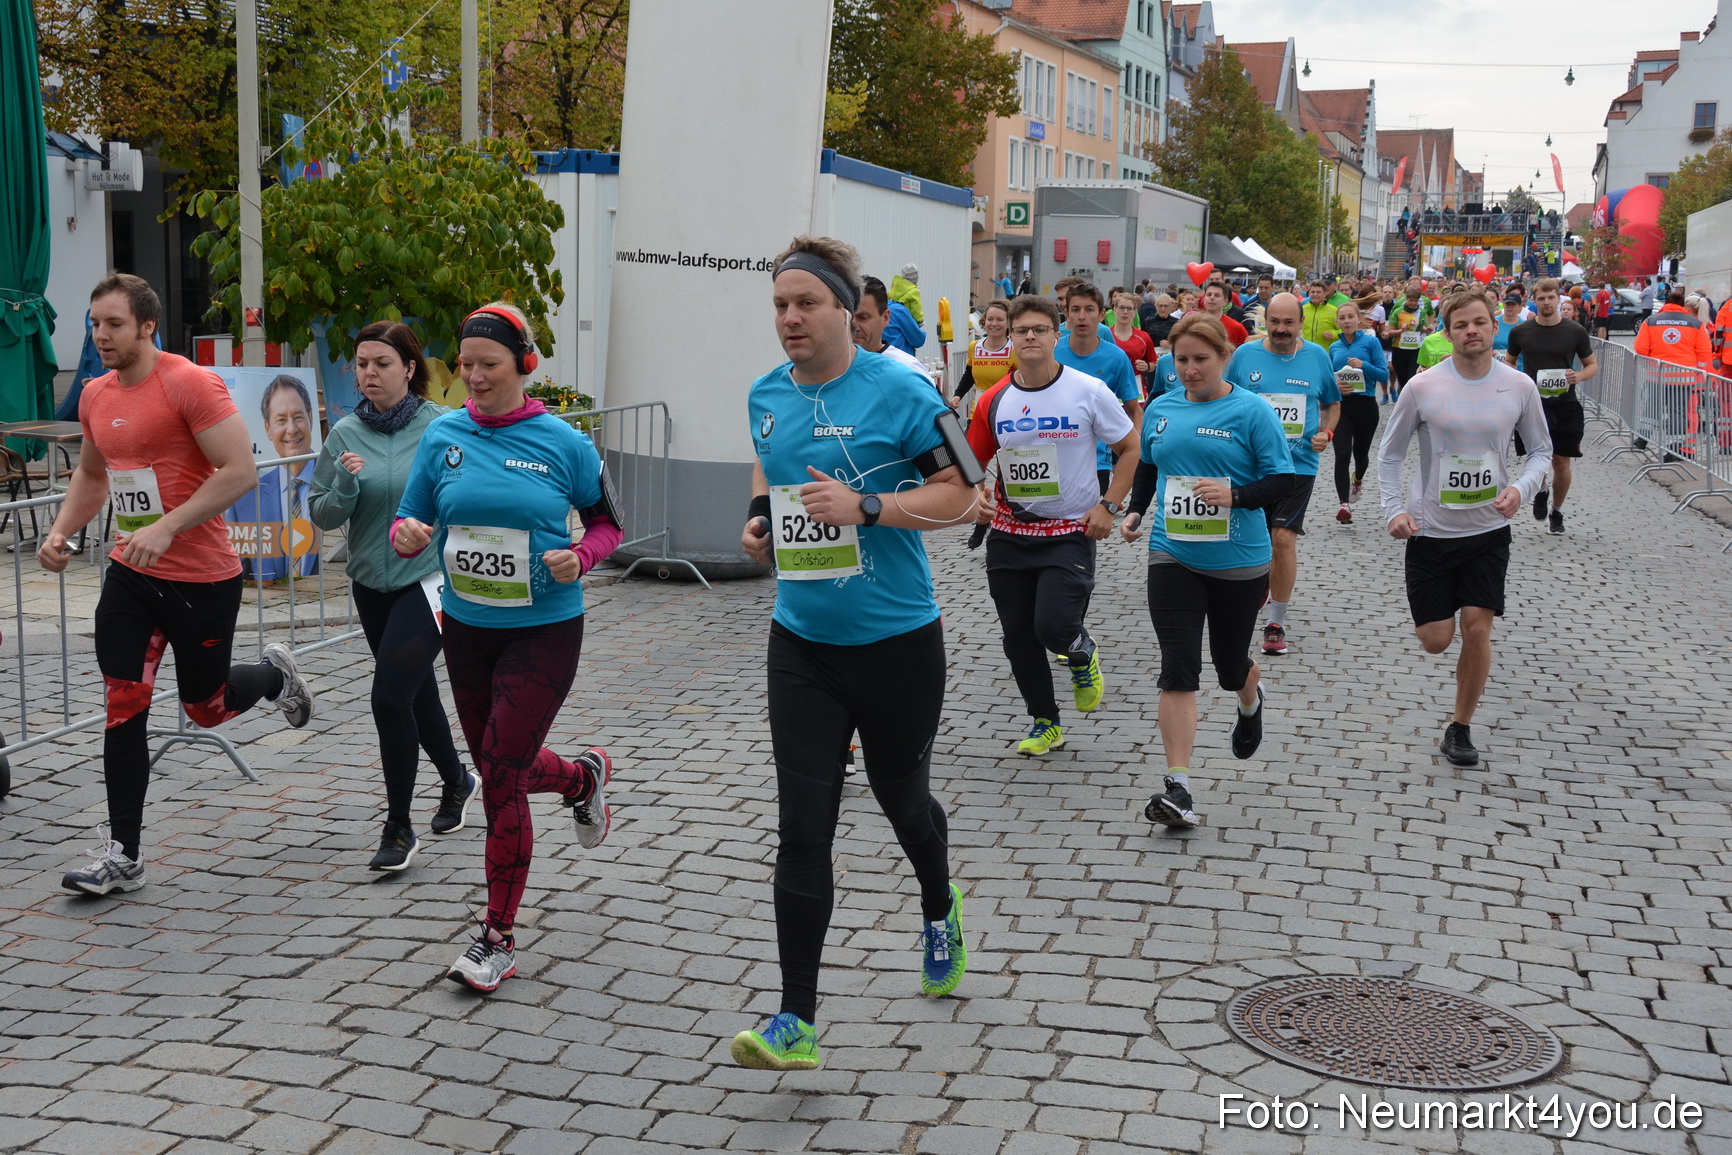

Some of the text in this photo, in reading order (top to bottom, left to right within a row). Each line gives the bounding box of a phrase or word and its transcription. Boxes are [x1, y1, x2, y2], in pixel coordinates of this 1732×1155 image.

[92, 172, 104, 181] Hut
[113, 172, 130, 181] Mode
[1010, 206, 1026, 222] D
[1463, 236, 1484, 245] ZIEL
[615, 248, 774, 272] www.bmw-laufsport.de
[1338, 372, 1361, 381] 5086
[1541, 378, 1566, 388] 5046
[814, 426, 855, 437] BOCK
[1038, 428, 1079, 439] energie
[1196, 426, 1232, 439] BOCK
[505, 459, 549, 474] BOCK
[1009, 461, 1051, 481] 5082
[1448, 469, 1492, 488] 5016
[114, 490, 151, 513] 5179
[1460, 493, 1482, 501] Marcel
[227, 526, 273, 541] OMAS
[782, 514, 841, 543] 5236
[1184, 522, 1203, 530] Karin
[232, 542, 272, 555] MANN
[456, 550, 516, 577] 5235
[793, 551, 834, 567] Christian
[470, 579, 503, 595] Sabine
